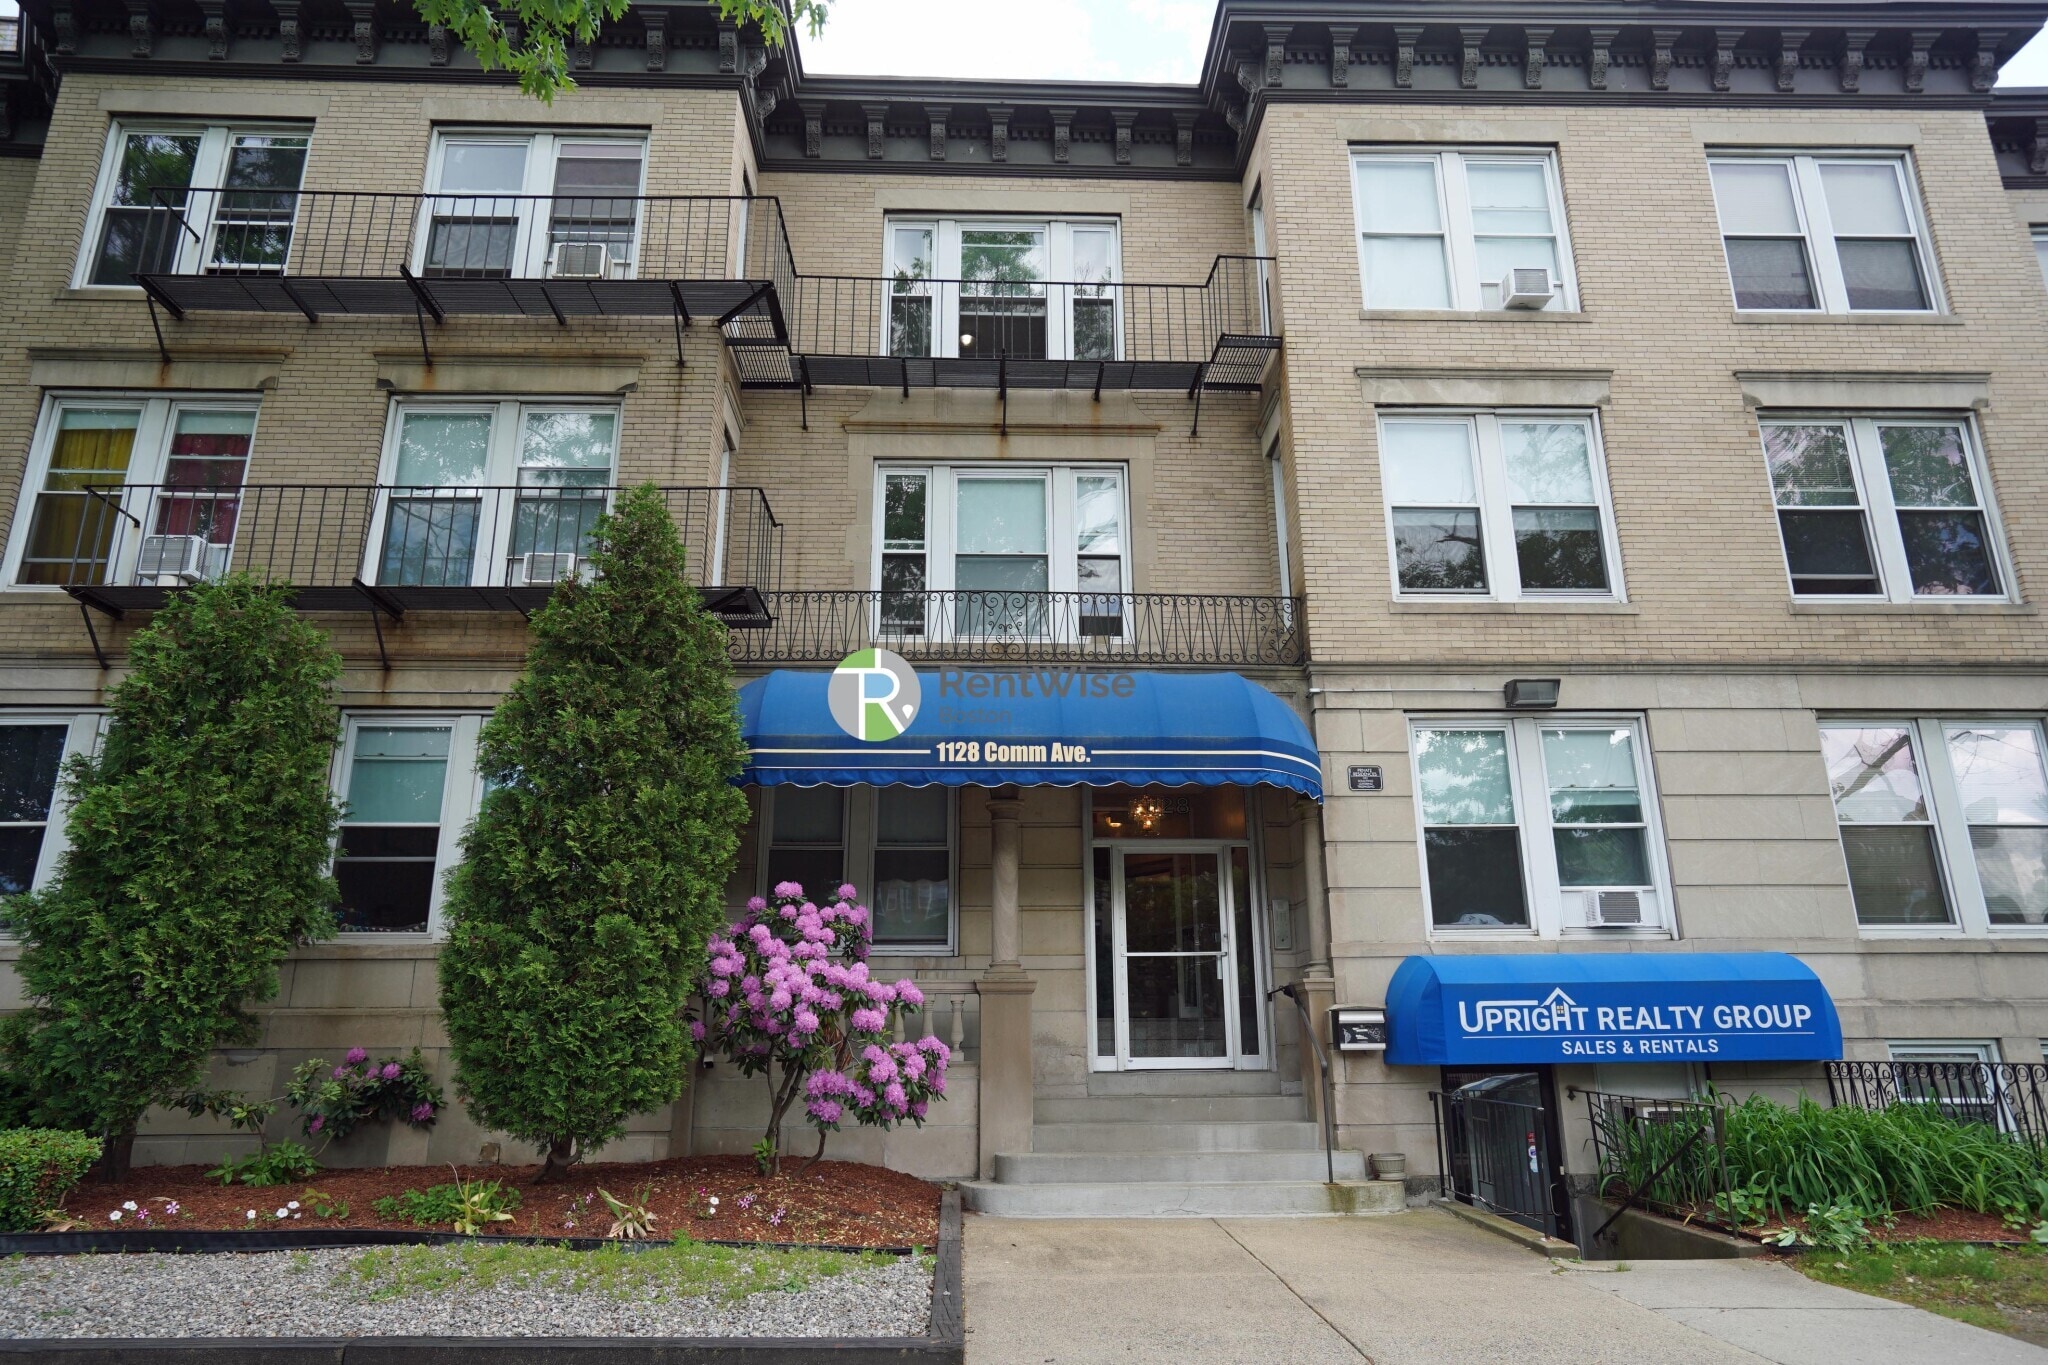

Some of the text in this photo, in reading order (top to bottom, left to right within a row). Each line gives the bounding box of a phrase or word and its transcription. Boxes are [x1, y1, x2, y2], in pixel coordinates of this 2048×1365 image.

[936, 742, 1091, 763] 1128 Comm Ave.
[1458, 986, 1812, 1033] UPRIGHT REALTY GROUP
[1562, 1039, 1719, 1055] SALES & RENTALS
